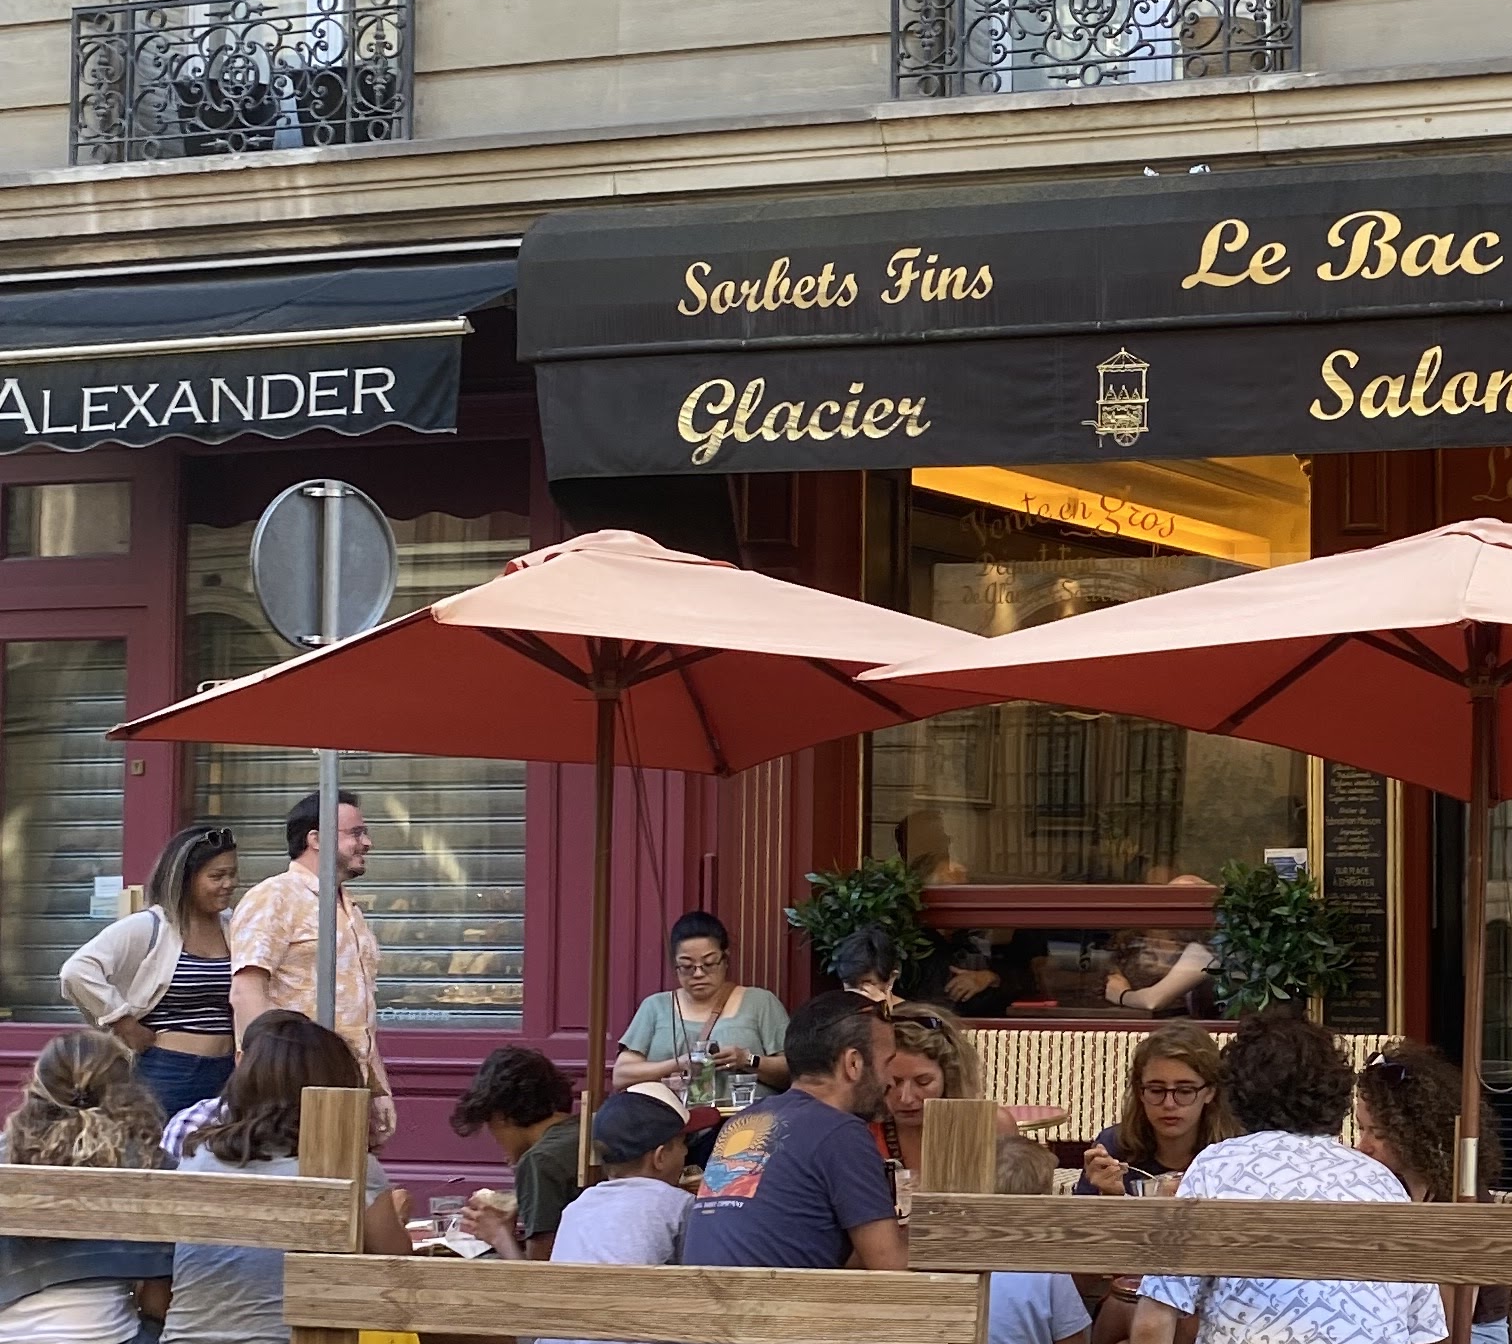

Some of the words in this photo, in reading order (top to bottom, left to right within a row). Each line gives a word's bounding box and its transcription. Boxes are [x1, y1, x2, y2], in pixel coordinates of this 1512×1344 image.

[677, 256, 859, 316] Sorbets
[880, 247, 994, 304] Fins
[1181, 218, 1291, 290] Le
[1316, 210, 1504, 282] Bac
[0, 366, 397, 435] ALEXANDER
[677, 378, 932, 466] Glacier
[961, 493, 1052, 546] Vente
[1058, 496, 1093, 521] en
